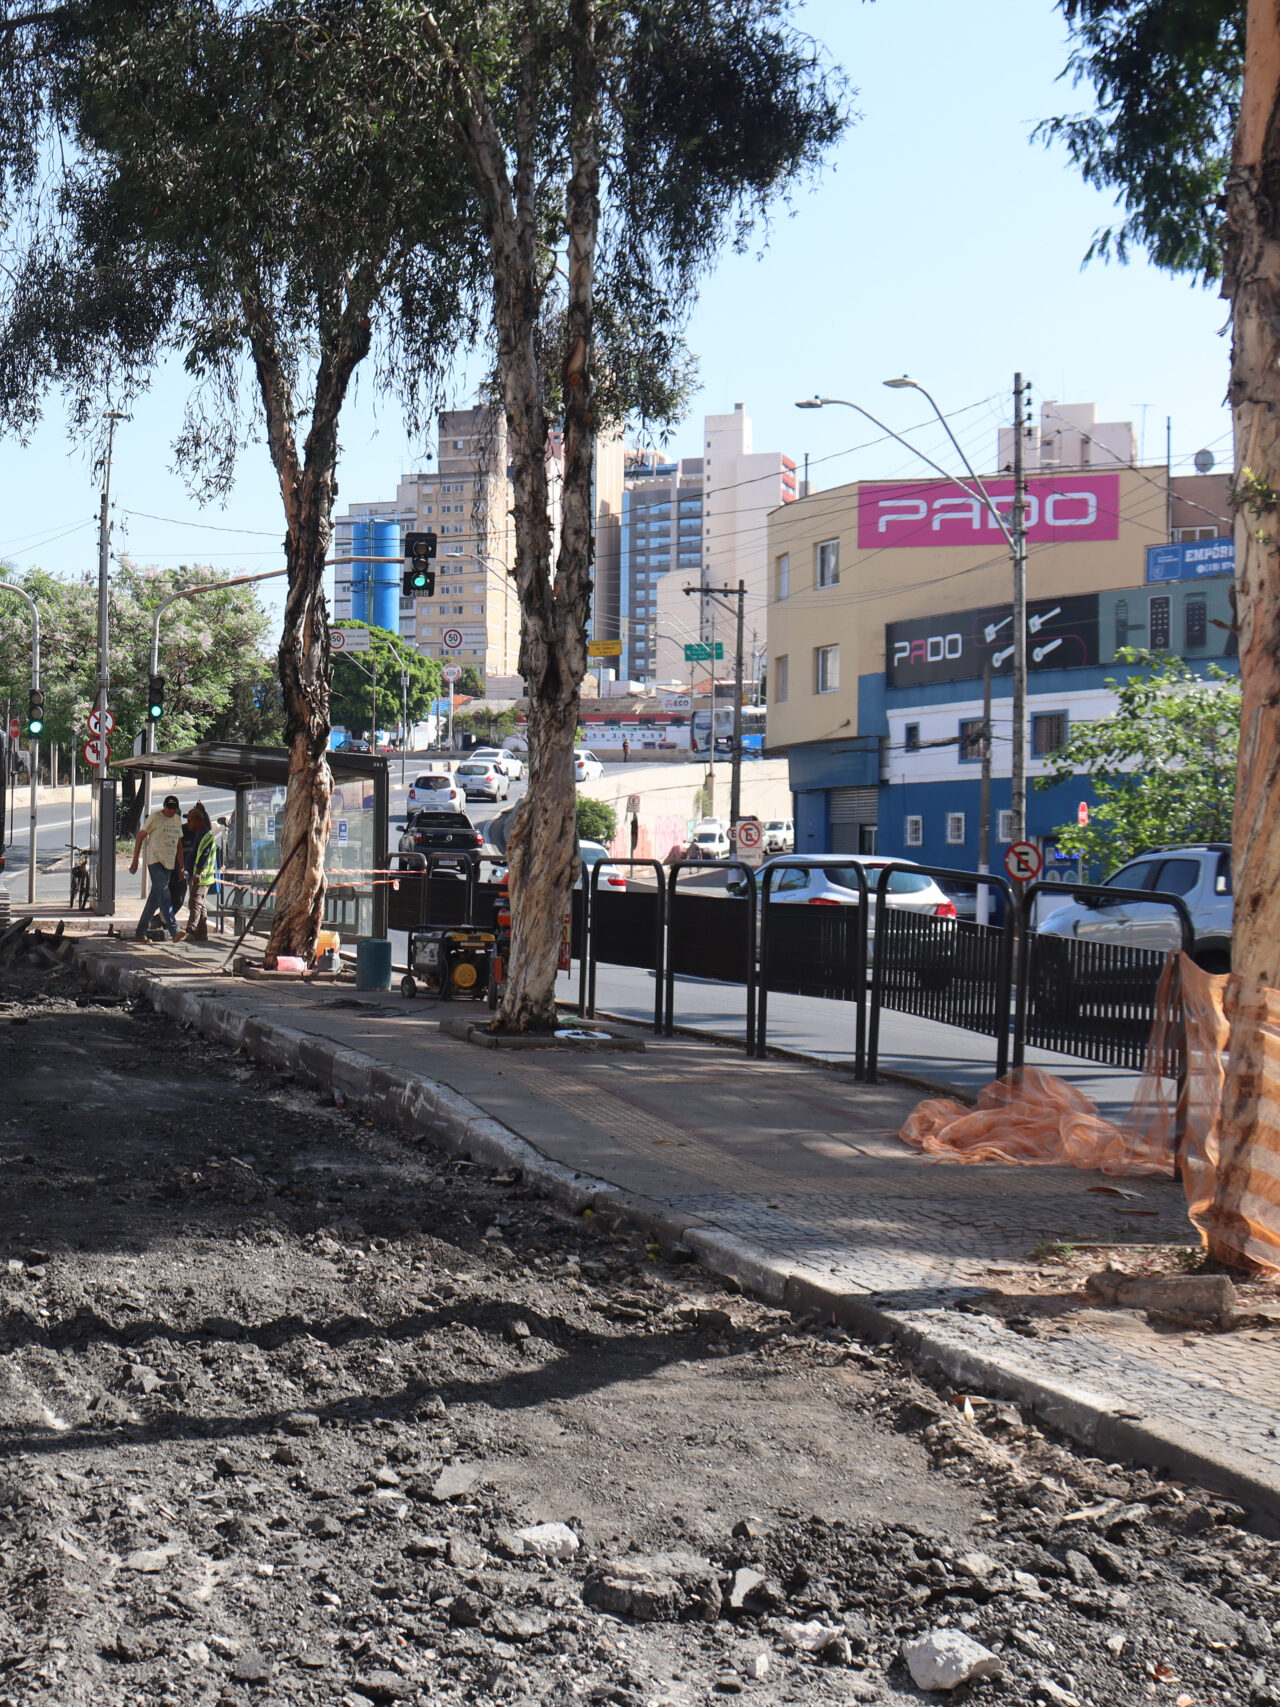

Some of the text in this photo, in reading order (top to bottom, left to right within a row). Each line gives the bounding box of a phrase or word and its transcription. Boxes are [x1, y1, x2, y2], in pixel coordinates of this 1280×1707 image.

[878, 492, 1097, 532] PADO
[1185, 543, 1234, 563] EMPÓRI
[410, 589, 429, 597] 289B
[332, 635, 341, 643] 50
[448, 633, 458, 642] 50
[894, 633, 962, 667] PADO
